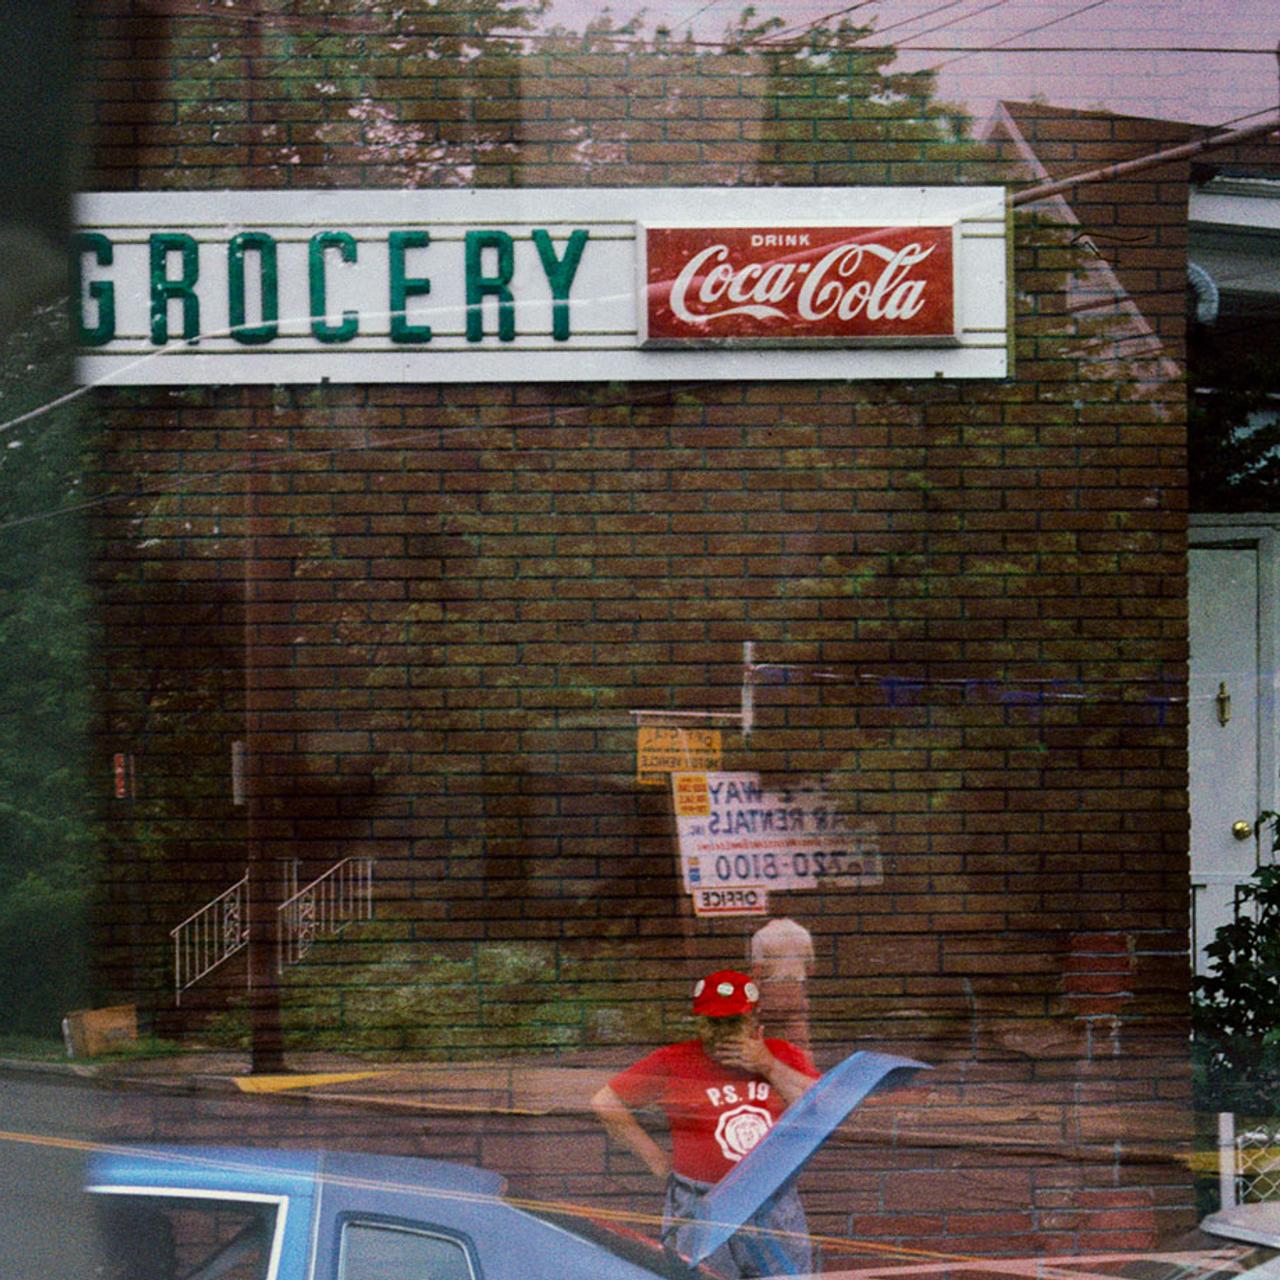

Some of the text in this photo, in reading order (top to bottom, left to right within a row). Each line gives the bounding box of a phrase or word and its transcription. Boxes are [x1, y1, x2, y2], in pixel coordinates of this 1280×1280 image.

[751, 234, 811, 247] DRINK
[74, 229, 590, 345] GROCERY
[670, 243, 938, 322] Coca-Cola
[705, 1080, 771, 1107] P.S. 19
